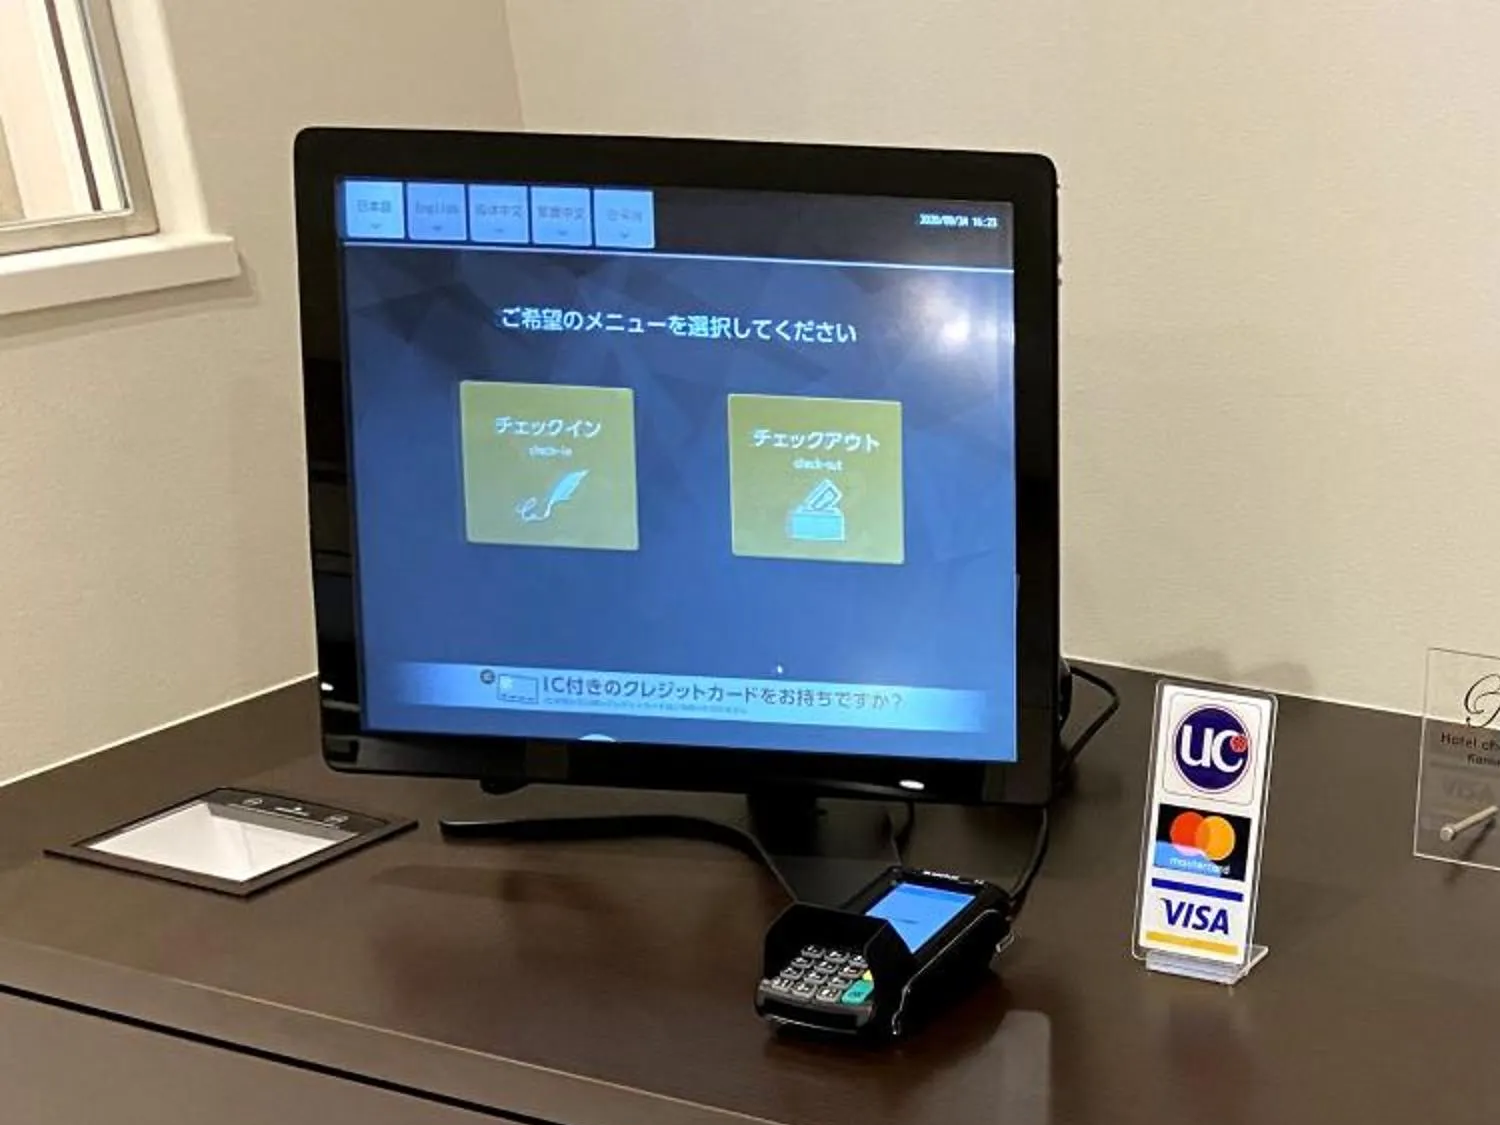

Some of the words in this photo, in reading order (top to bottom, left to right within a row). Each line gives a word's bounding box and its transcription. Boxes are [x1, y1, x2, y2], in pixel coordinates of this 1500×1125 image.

[501, 306, 858, 344] ご希望のメニューを選択してください
[495, 415, 602, 439] チェックイン
[752, 429, 881, 453] チェックアウト
[1440, 731, 1477, 749] Hotel
[1168, 856, 1231, 875] mastercard
[1159, 897, 1230, 935] VISA
